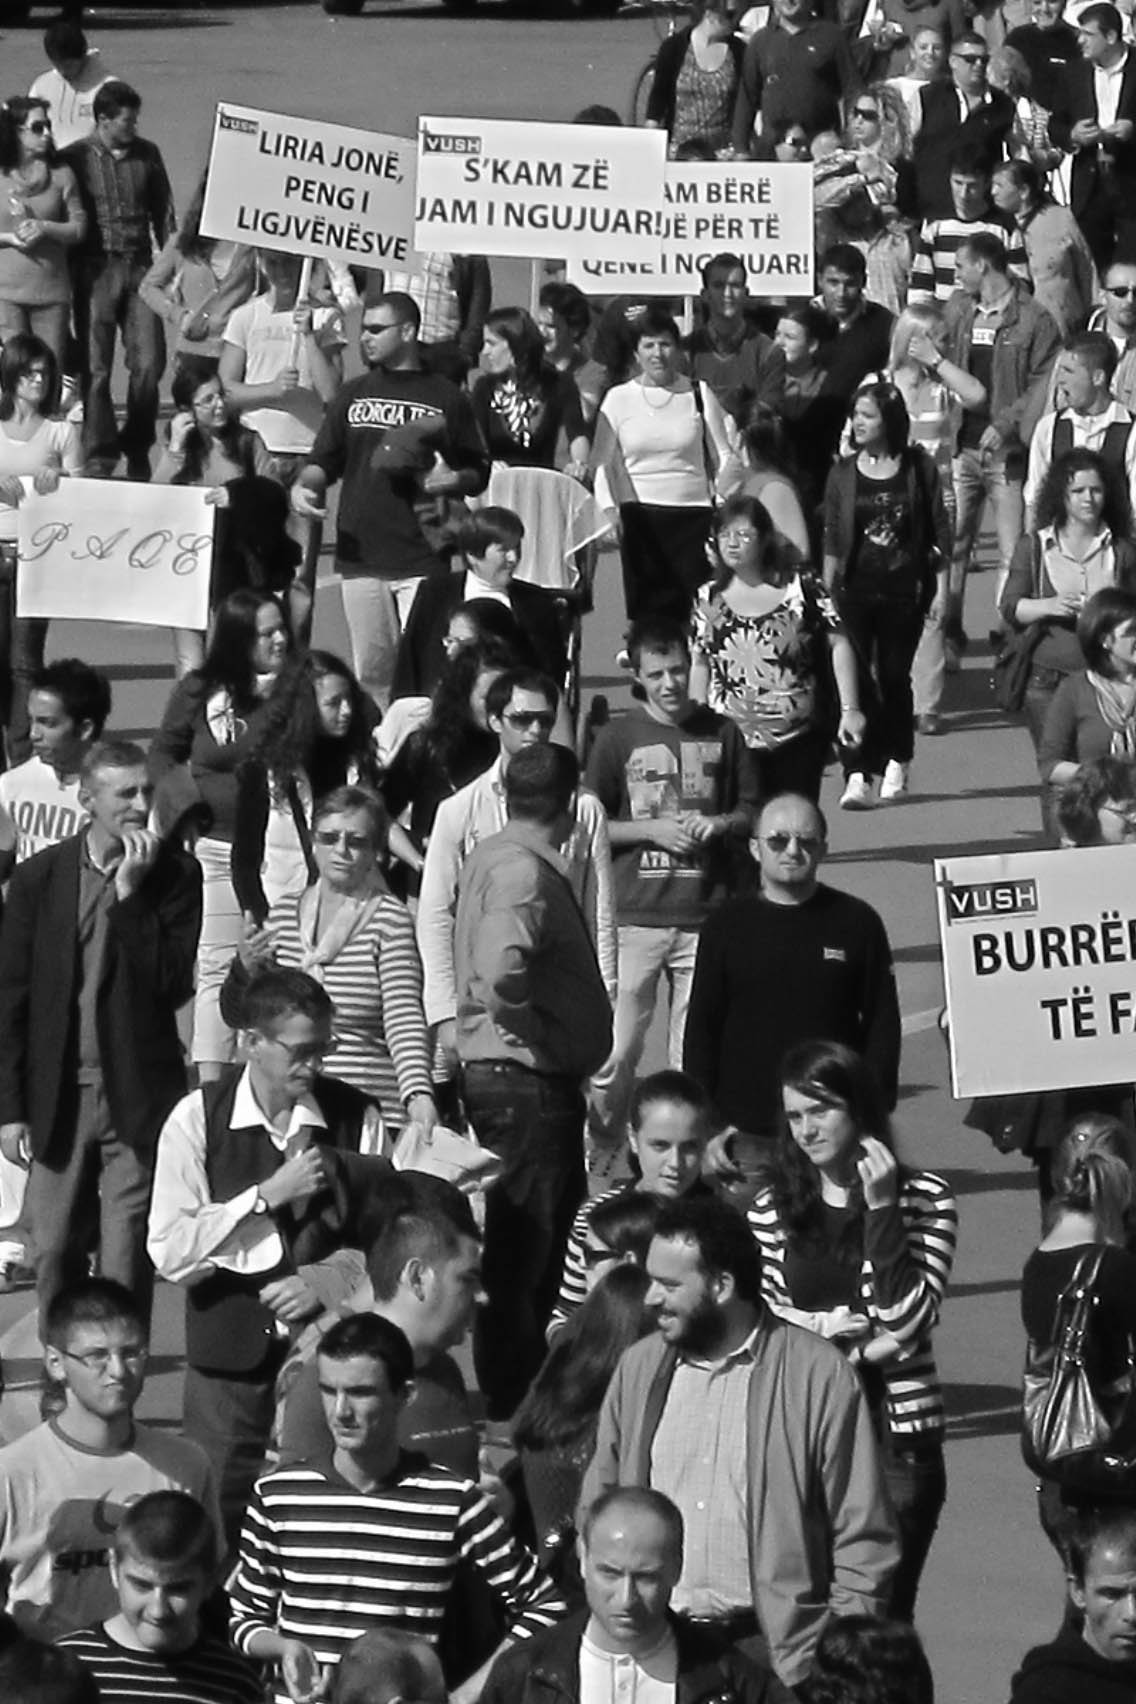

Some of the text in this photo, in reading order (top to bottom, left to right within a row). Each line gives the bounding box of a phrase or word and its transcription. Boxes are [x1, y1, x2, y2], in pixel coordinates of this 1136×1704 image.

[259, 131, 403, 183] LIRIA JONË,
[427, 136, 481, 152] VUSH
[464, 157, 609, 190] S'KAM ZË
[664, 177, 771, 203] AM BËRË
[284, 175, 370, 214] PENG I
[237, 206, 408, 261] LIGJVËNËSVE
[416, 197, 662, 236] JAM I NGUJUAR!
[695, 213, 743, 239] PËR
[749, 213, 780, 239] TË
[661, 253, 667, 275] I
[675, 253, 809, 275] NGUAR!
[10, 801, 89, 840] OND
[950, 886, 1036, 913] VUSH
[1040, 985, 1097, 1041] TË
